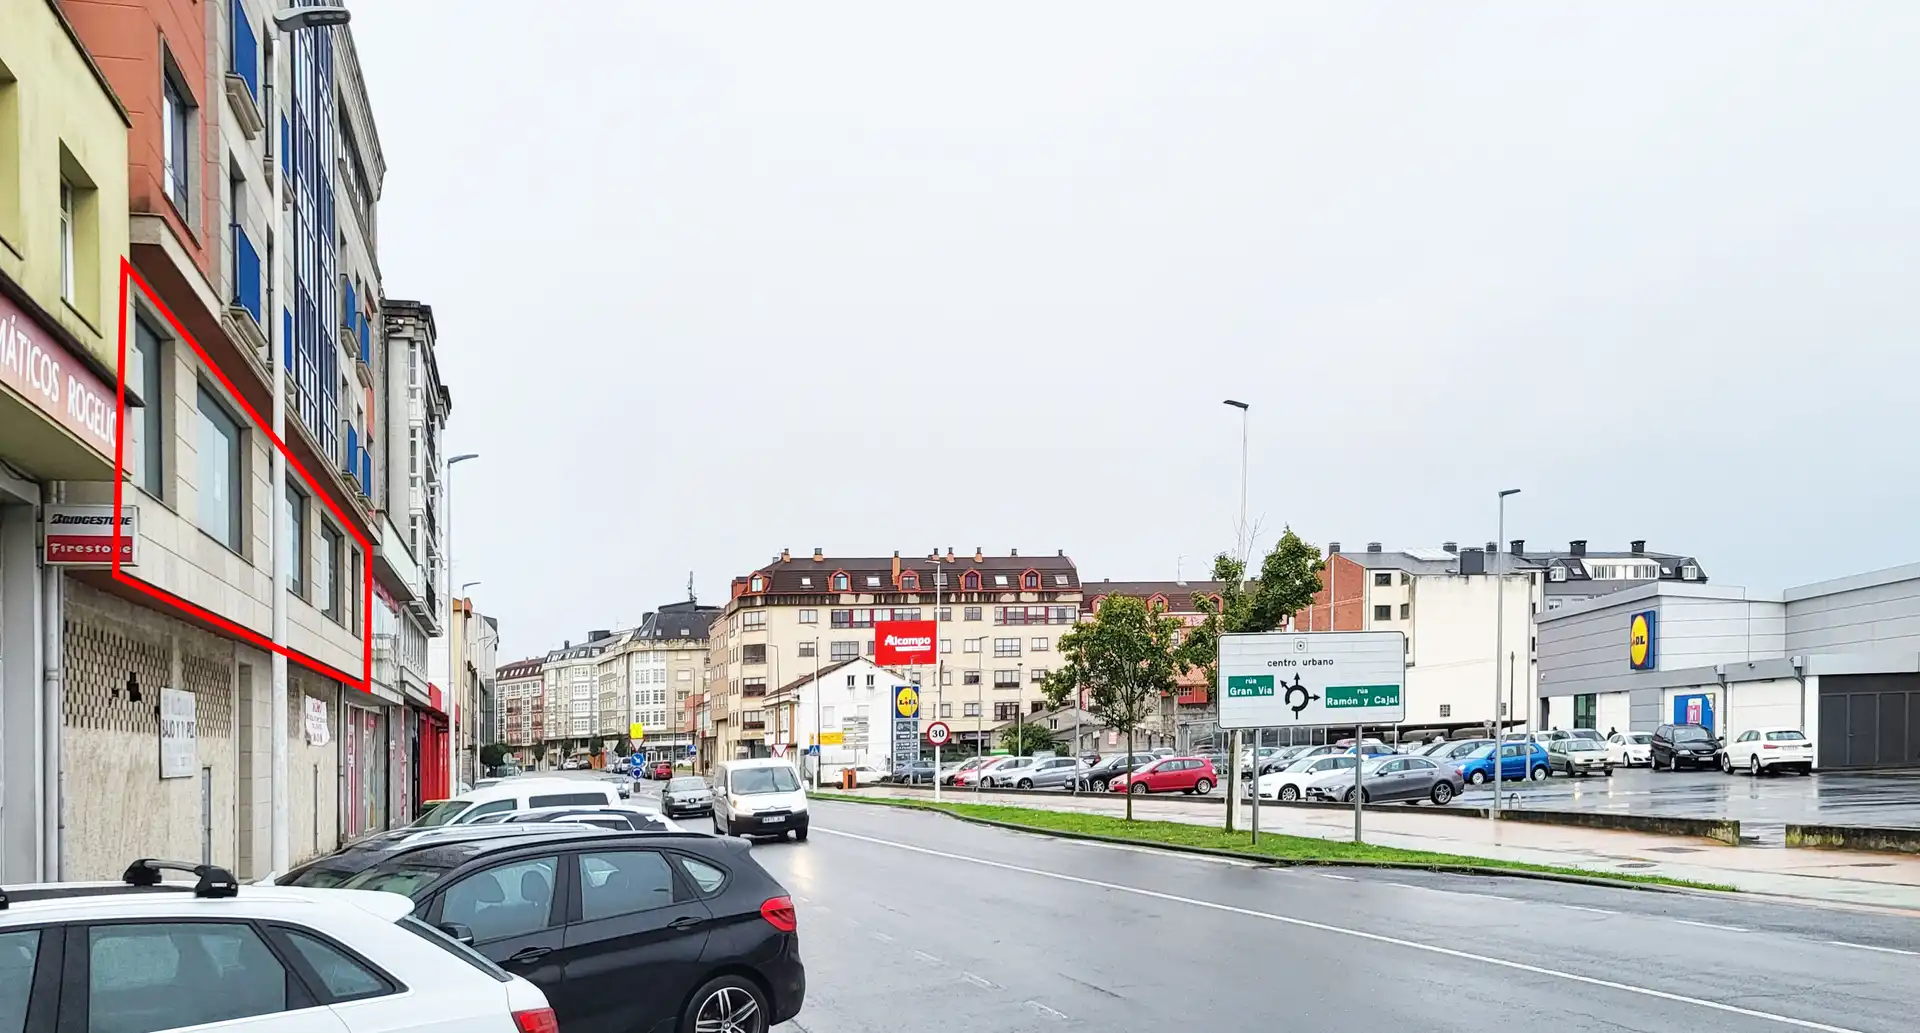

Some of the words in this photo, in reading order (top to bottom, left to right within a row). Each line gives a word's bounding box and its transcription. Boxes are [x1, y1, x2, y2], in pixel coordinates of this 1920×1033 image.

[50, 542, 132, 554] Firestoe
[884, 634, 931, 646] Alcampo
[1267, 658, 1297, 667] centro
[1302, 657, 1334, 666] urbano
[1229, 686, 1253, 696] Gran
[1357, 687, 1369, 695] rúa
[1327, 696, 1358, 706] Ramón
[1363, 698, 1369, 706] y
[1374, 695, 1398, 706] Cajal
[932, 729, 945, 738] 30
